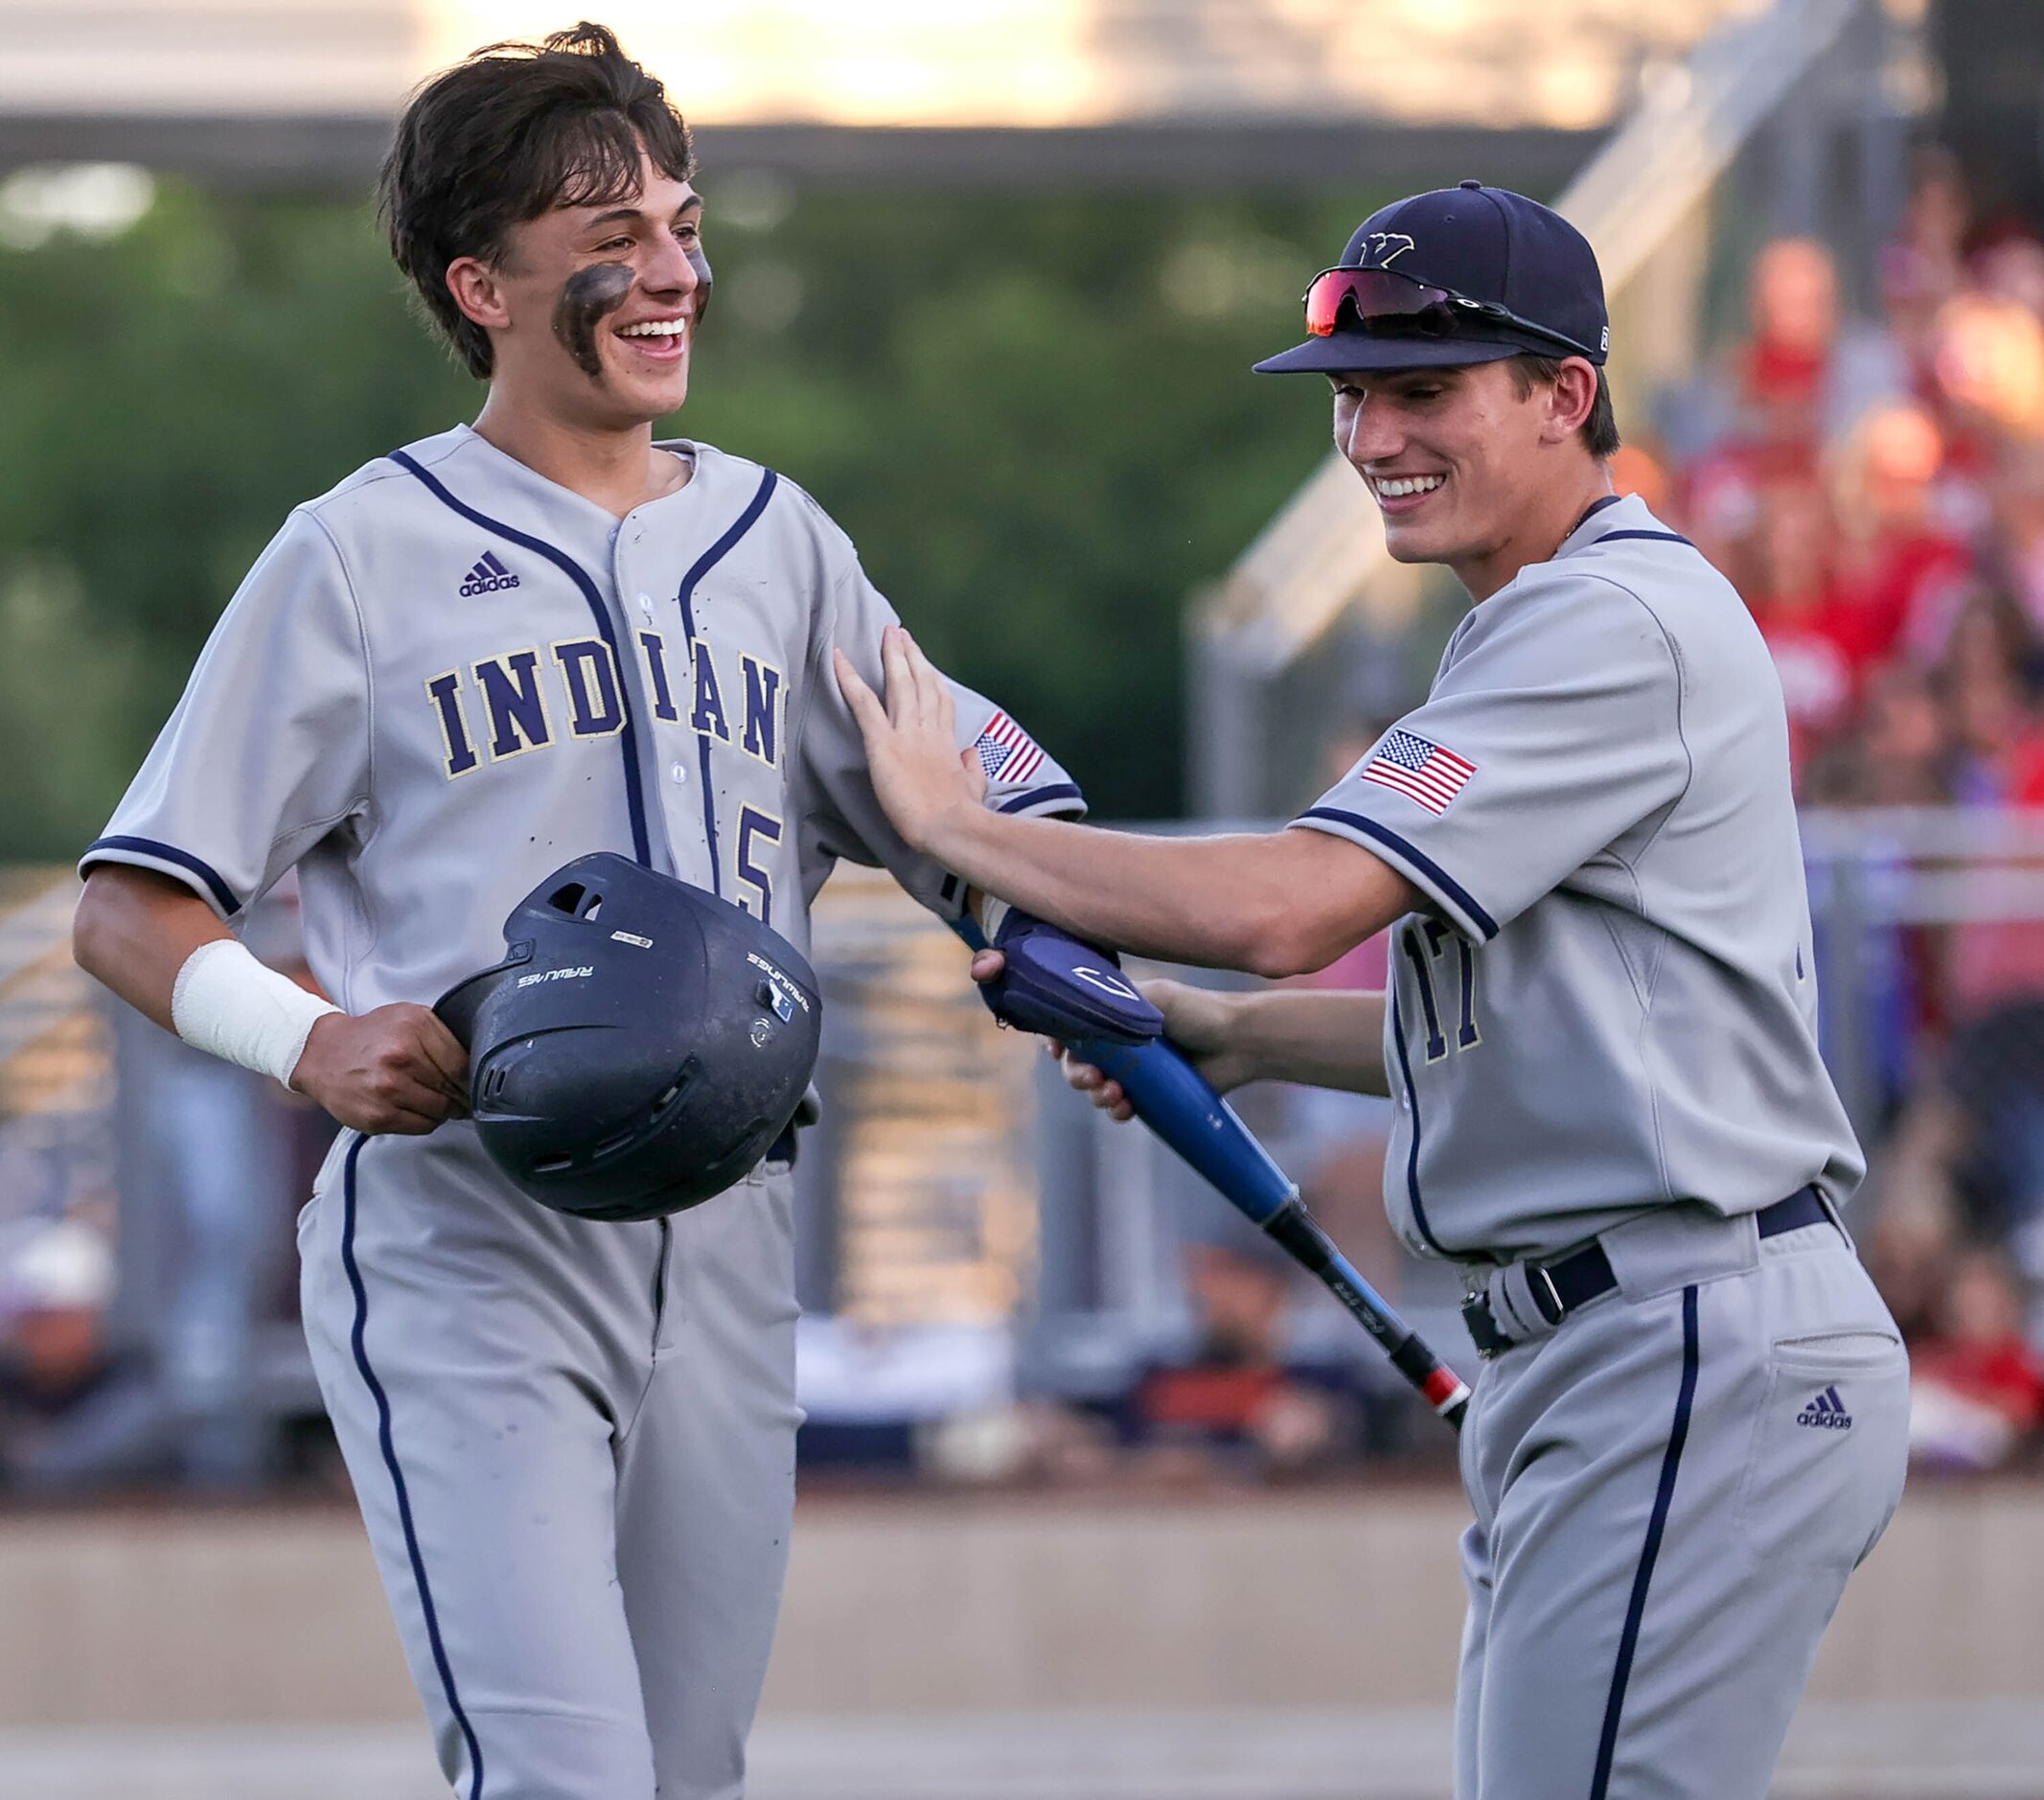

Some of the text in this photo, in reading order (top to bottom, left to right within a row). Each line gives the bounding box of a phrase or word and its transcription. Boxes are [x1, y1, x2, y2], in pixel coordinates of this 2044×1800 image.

[459, 574, 520, 598] adidas
[425, 629, 791, 781] INDIAN
[736, 801, 782, 925] 5
[746, 952, 810, 1013] RAWLINGS
[1402, 919, 1482, 1065] 17
[1797, 1411, 1852, 1430] adidas
